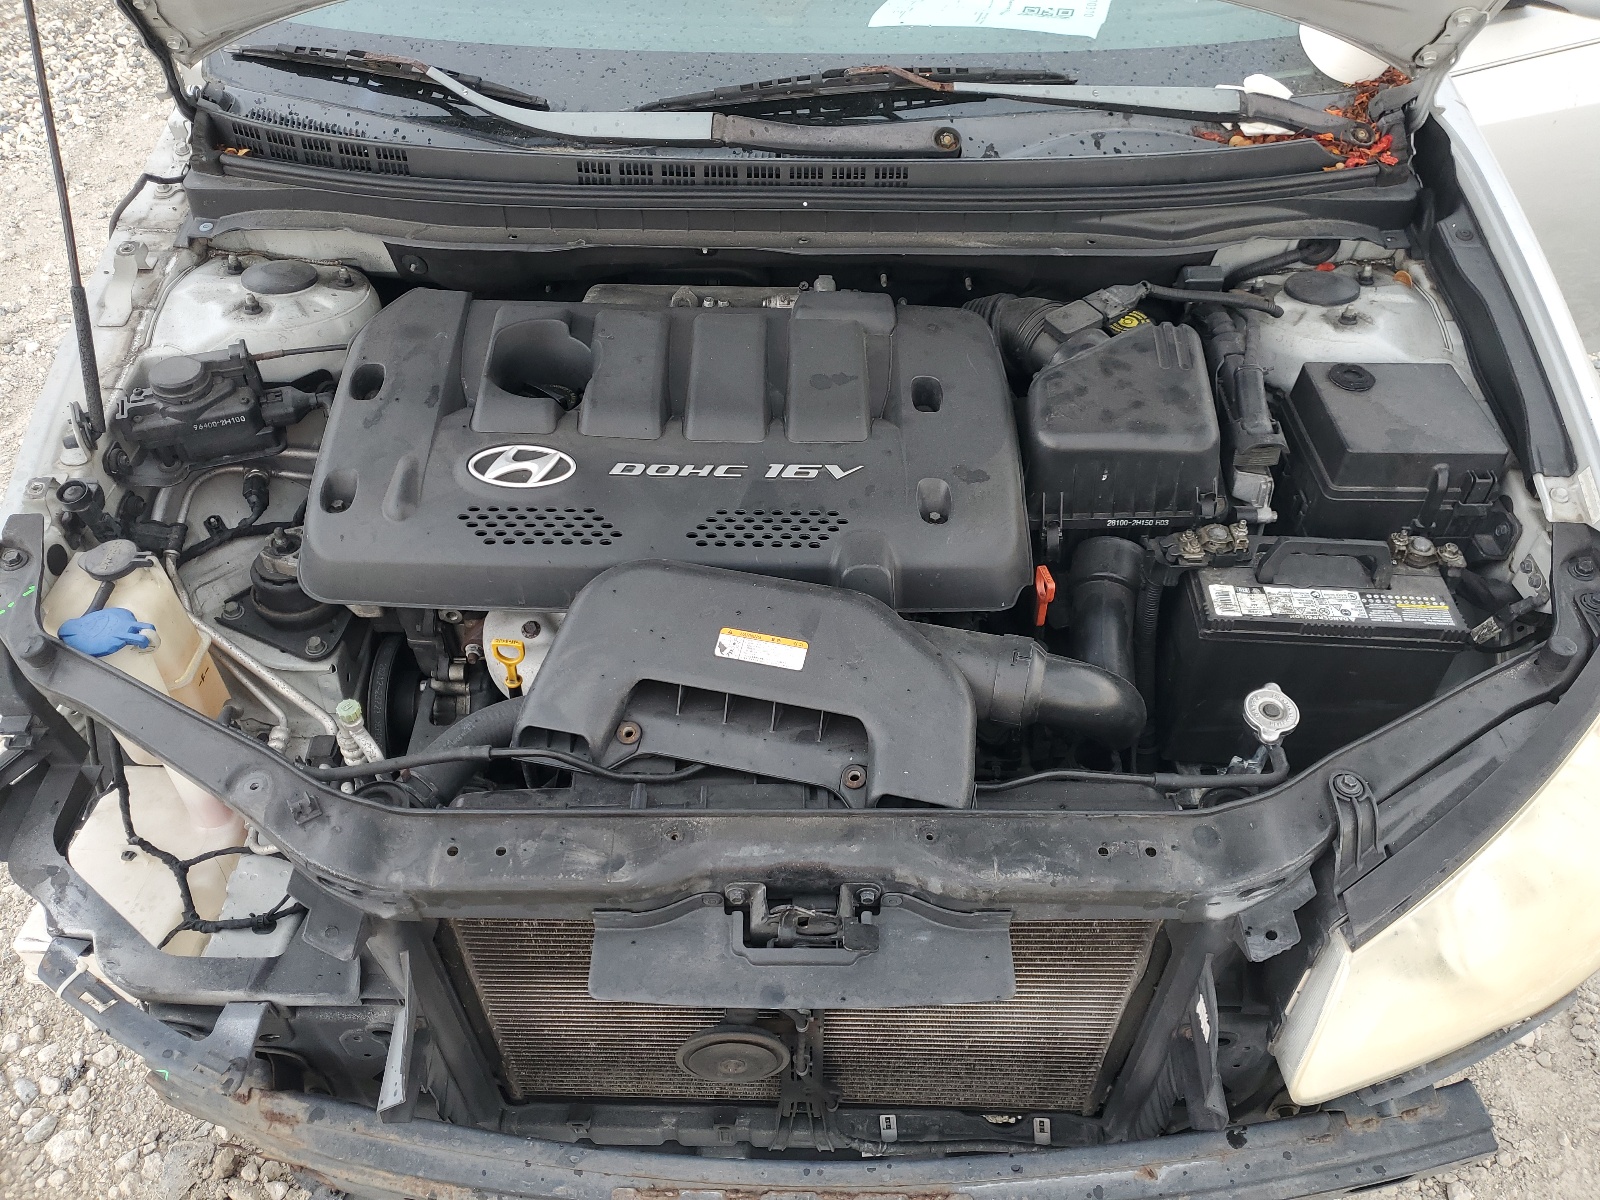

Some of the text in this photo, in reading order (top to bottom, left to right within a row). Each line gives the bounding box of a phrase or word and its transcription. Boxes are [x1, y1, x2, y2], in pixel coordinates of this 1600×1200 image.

[193, 415, 246, 430] 96400-2H100
[608, 461, 865, 480] DOHC 16V
[1106, 519, 1154, 527] 28100-2H150
